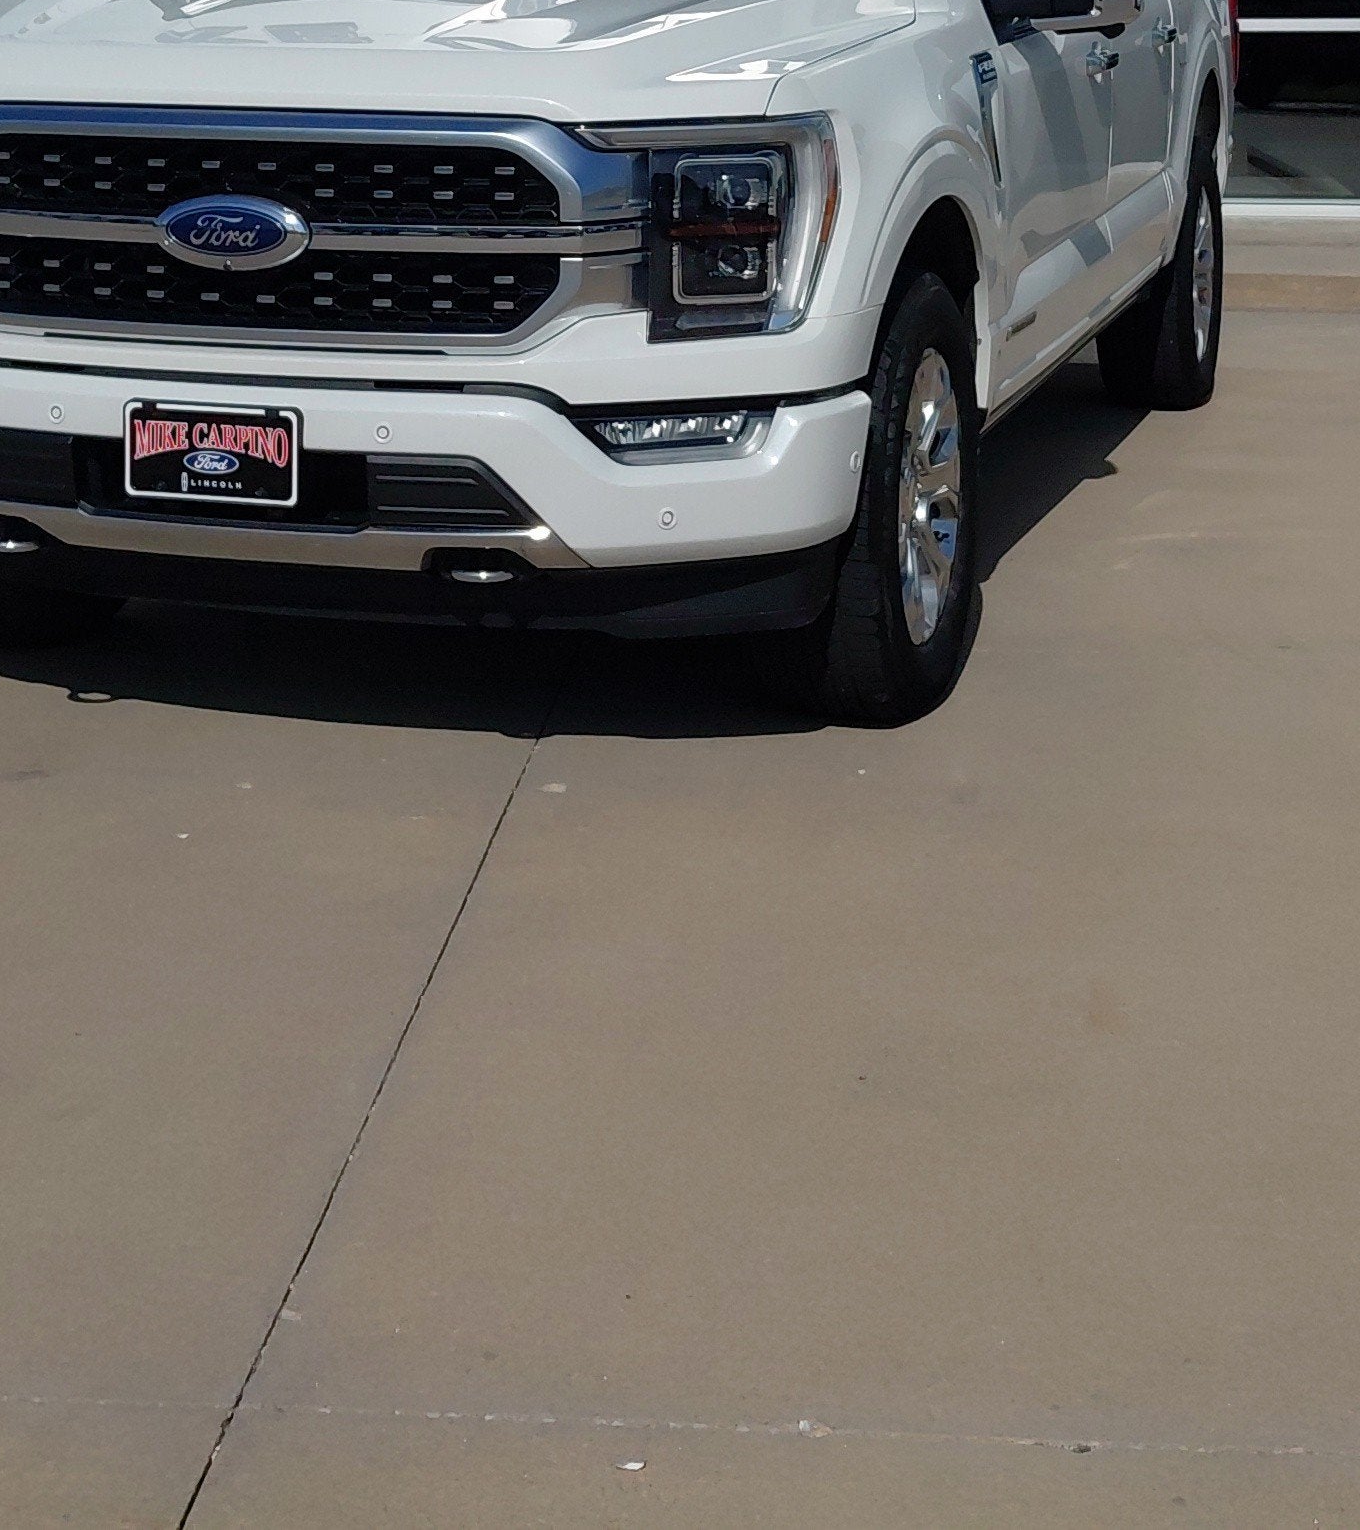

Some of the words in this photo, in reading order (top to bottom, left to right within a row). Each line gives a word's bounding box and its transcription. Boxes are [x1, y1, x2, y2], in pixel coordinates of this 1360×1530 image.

[190, 214, 261, 248] Ford
[134, 419, 189, 460] MIKE
[192, 422, 289, 468] CARPINO
[194, 454, 229, 470] Ford
[190, 478, 243, 490] LINCOLN
